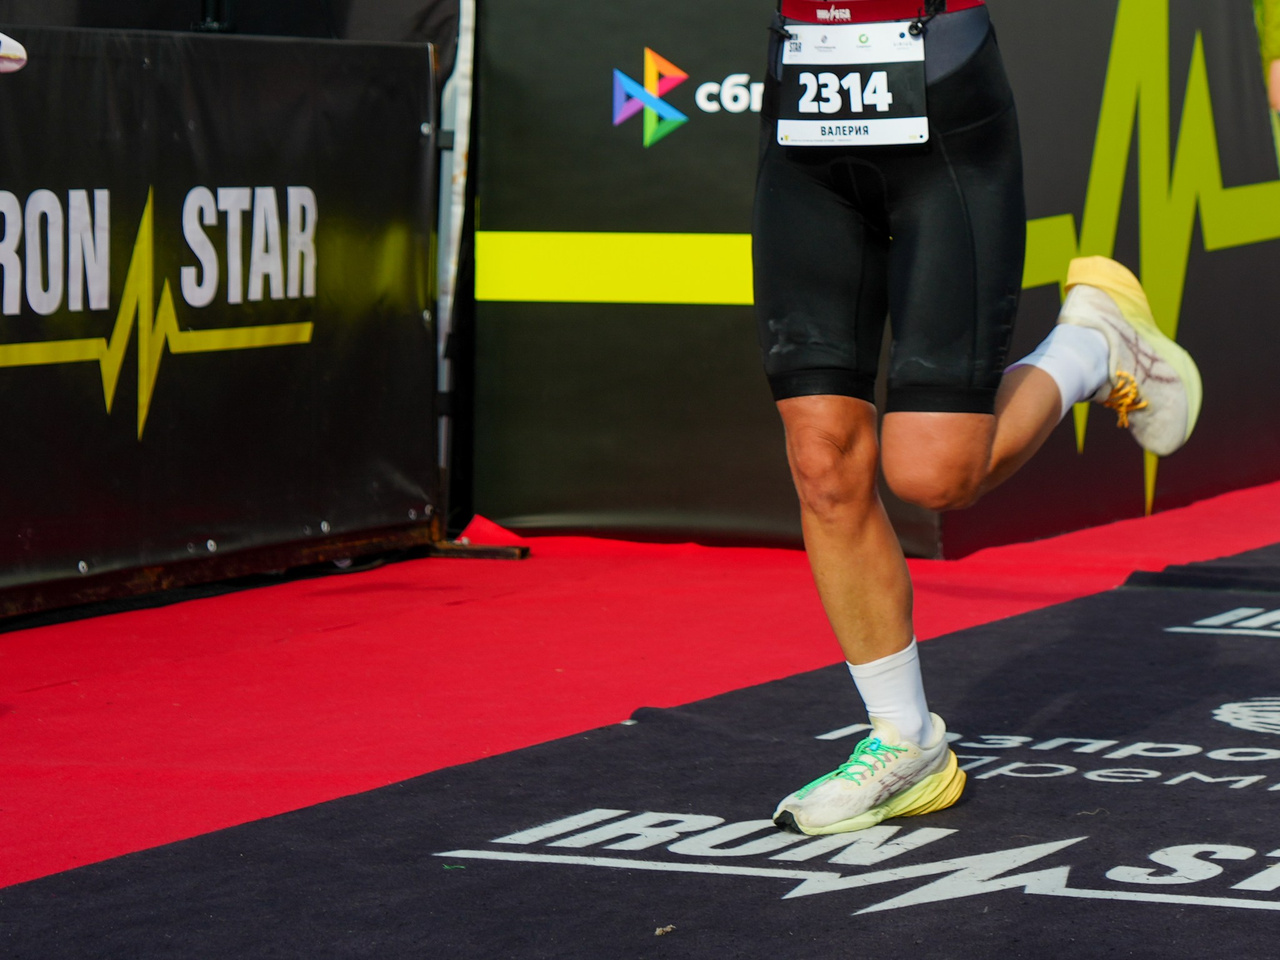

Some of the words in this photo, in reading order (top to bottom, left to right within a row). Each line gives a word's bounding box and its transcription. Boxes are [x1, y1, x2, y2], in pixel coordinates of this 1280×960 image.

[798, 71, 892, 114] 2314
[820, 125, 869, 136] ВАЛЕРИЯ
[181, 185, 318, 308] STAR
[489, 808, 960, 867] IRON
